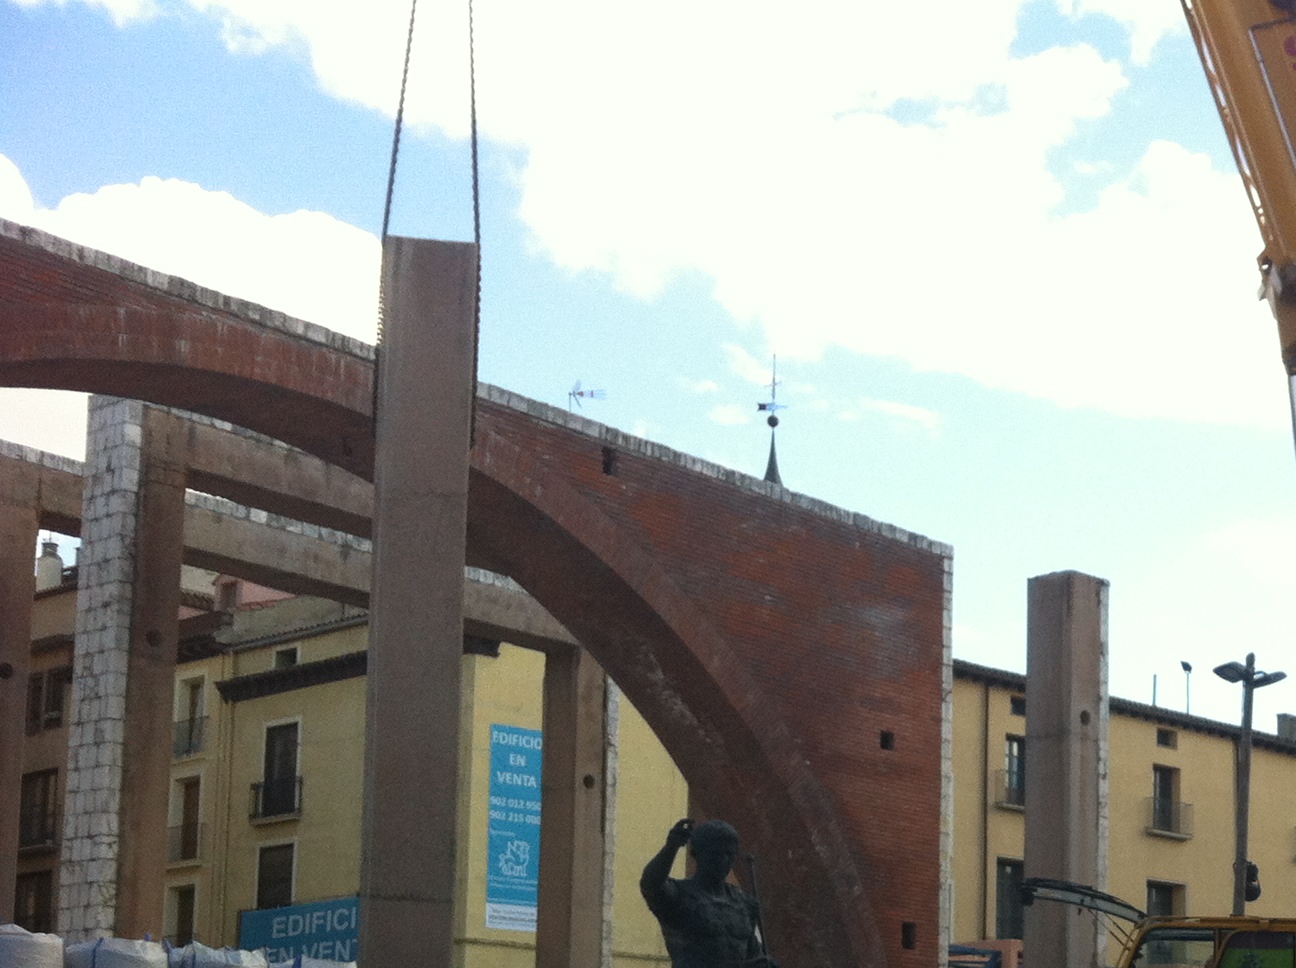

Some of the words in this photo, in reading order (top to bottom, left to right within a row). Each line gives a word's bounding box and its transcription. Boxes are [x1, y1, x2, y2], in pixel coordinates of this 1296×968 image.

[492, 730, 542, 750] EDIFICIO
[509, 753, 526, 767] EN
[497, 771, 537, 788] VENTA
[272, 907, 356, 938] EDIFICI
